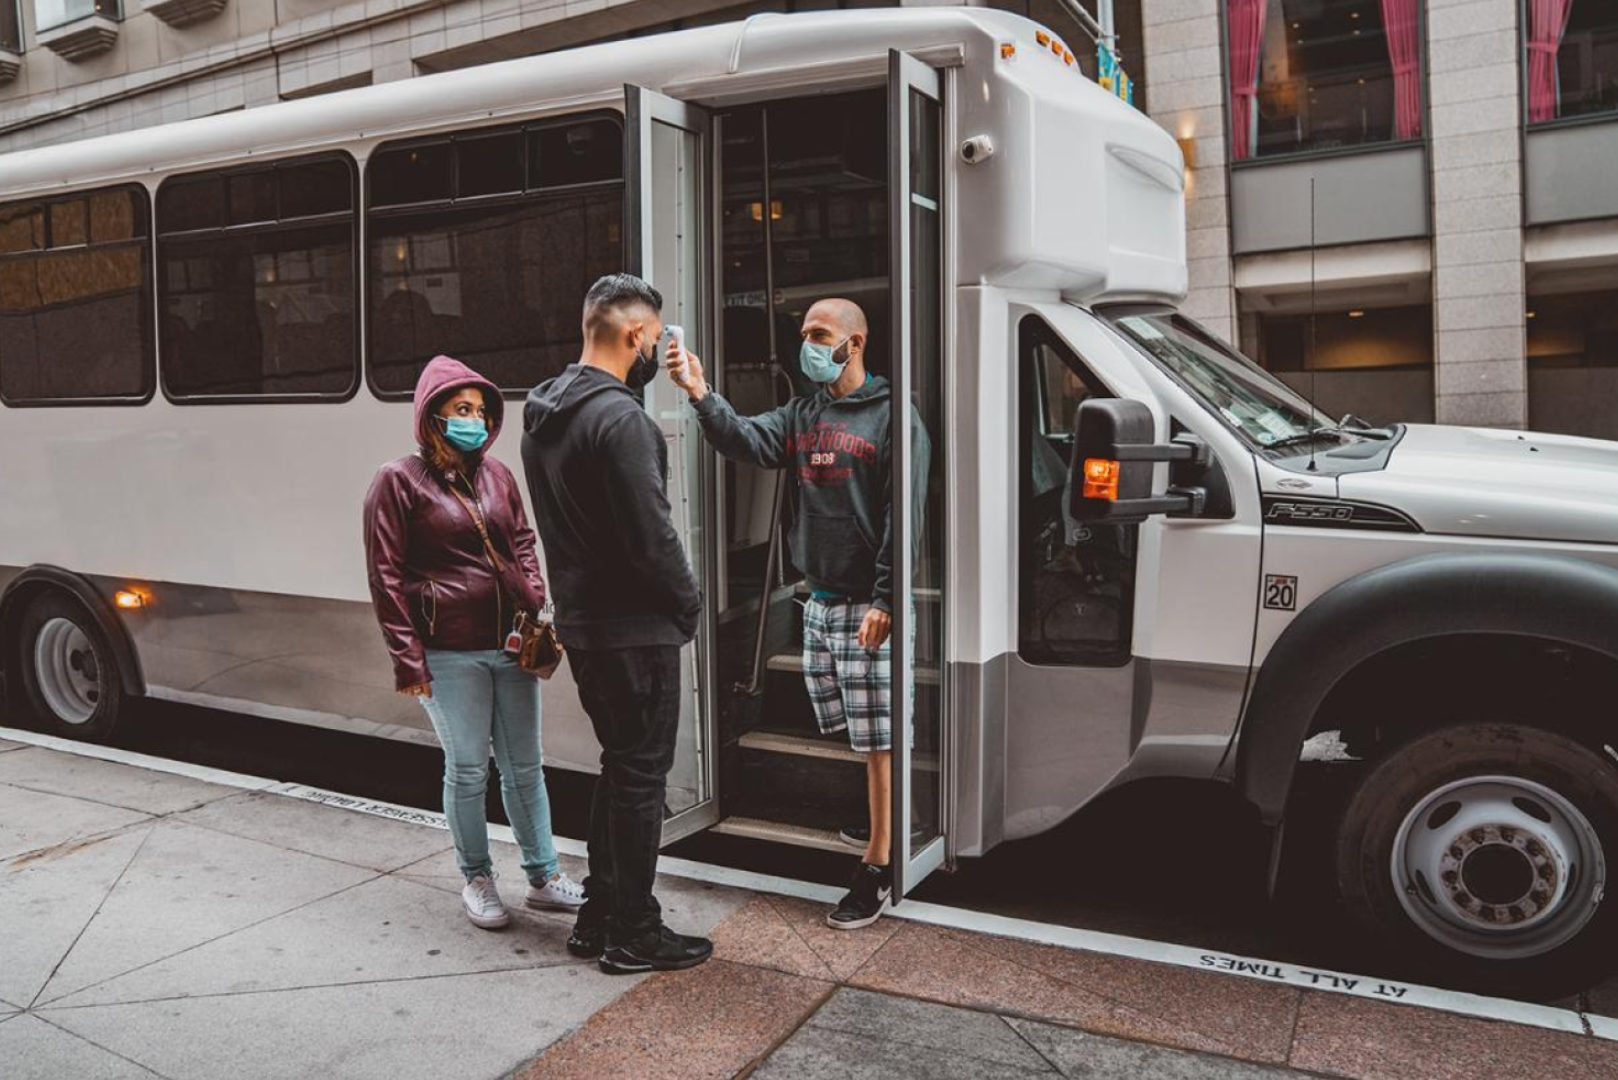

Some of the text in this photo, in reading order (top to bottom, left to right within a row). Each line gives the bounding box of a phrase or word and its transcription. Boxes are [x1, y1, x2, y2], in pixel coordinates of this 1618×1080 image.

[810, 451, 836, 465] 1908
[1267, 584, 1294, 608] 20
[1200, 954, 1408, 998] AT ALL TIMES
